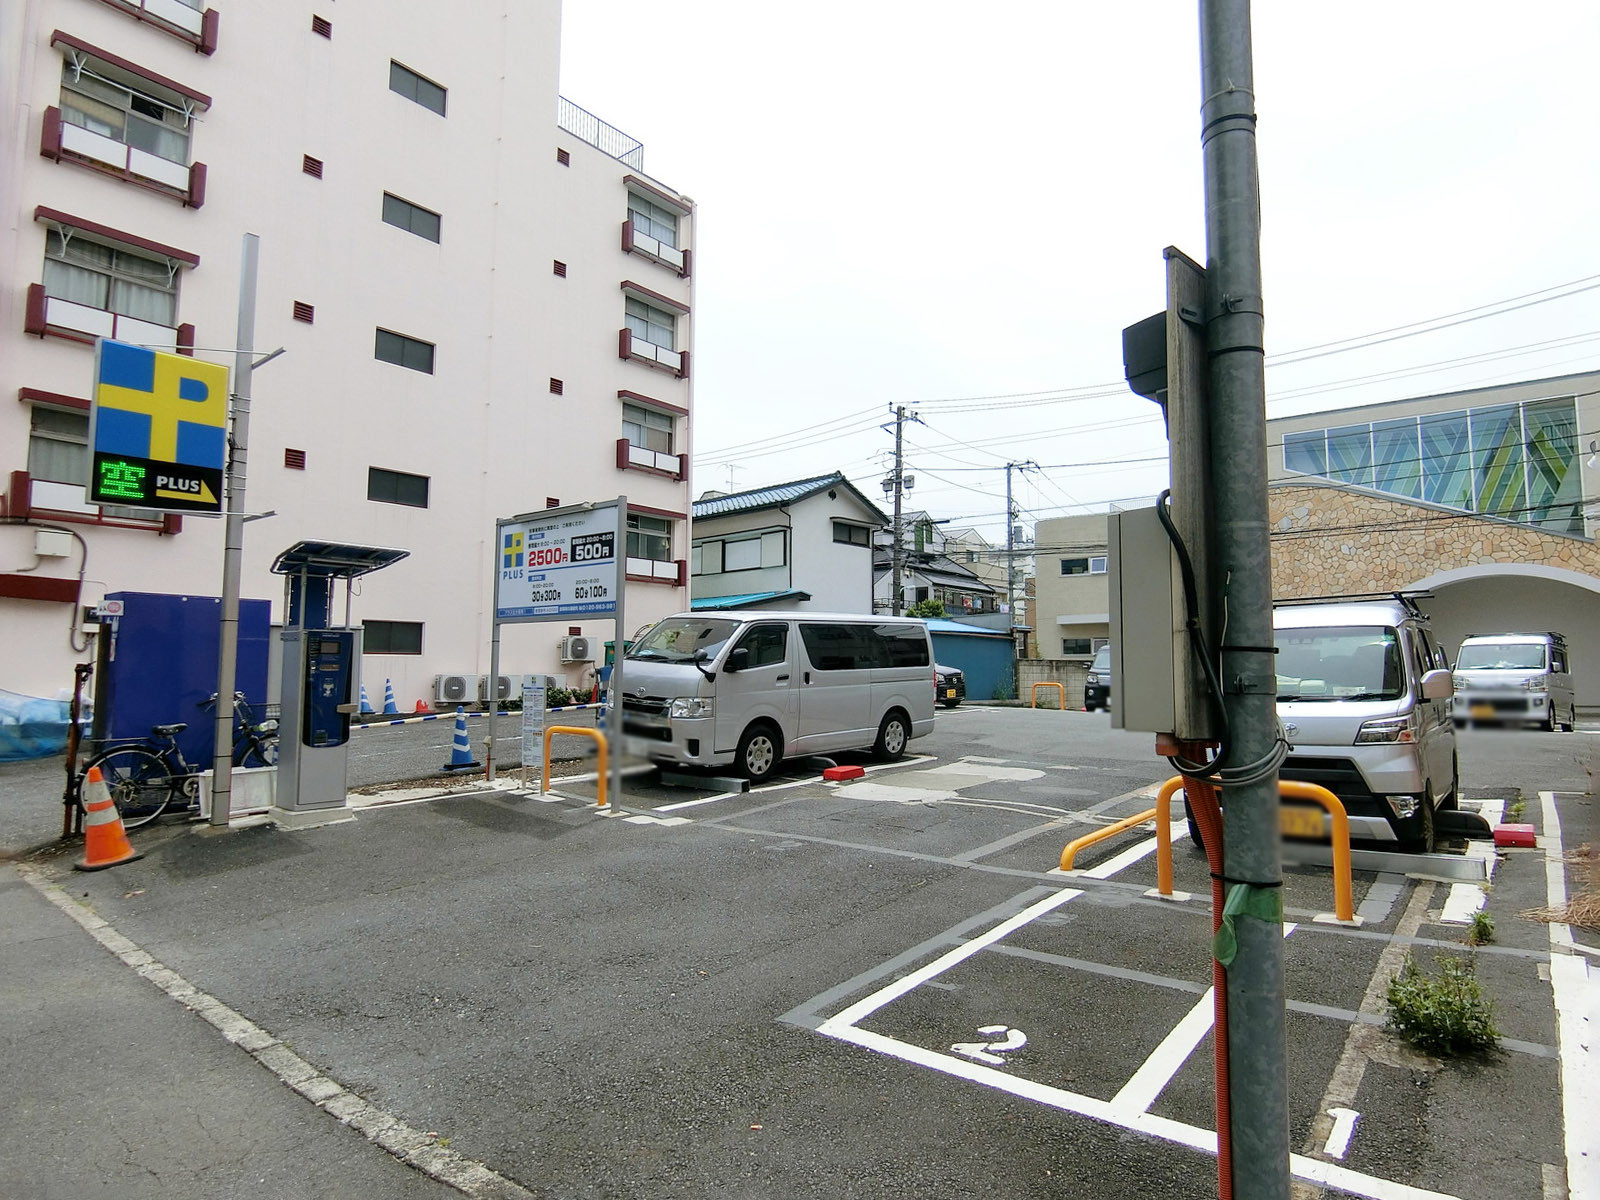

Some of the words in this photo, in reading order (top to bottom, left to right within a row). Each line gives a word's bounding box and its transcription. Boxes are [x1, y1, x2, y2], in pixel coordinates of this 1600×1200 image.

[100, 461, 146, 499] 空
[156, 475, 200, 492] PLUS
[528, 547, 568, 567] 2500円
[575, 543, 609, 560] 500円
[503, 569, 524, 580] PLUS
[950, 1023, 1028, 1066] 2
[1326, 1107, 1362, 1160] 1
